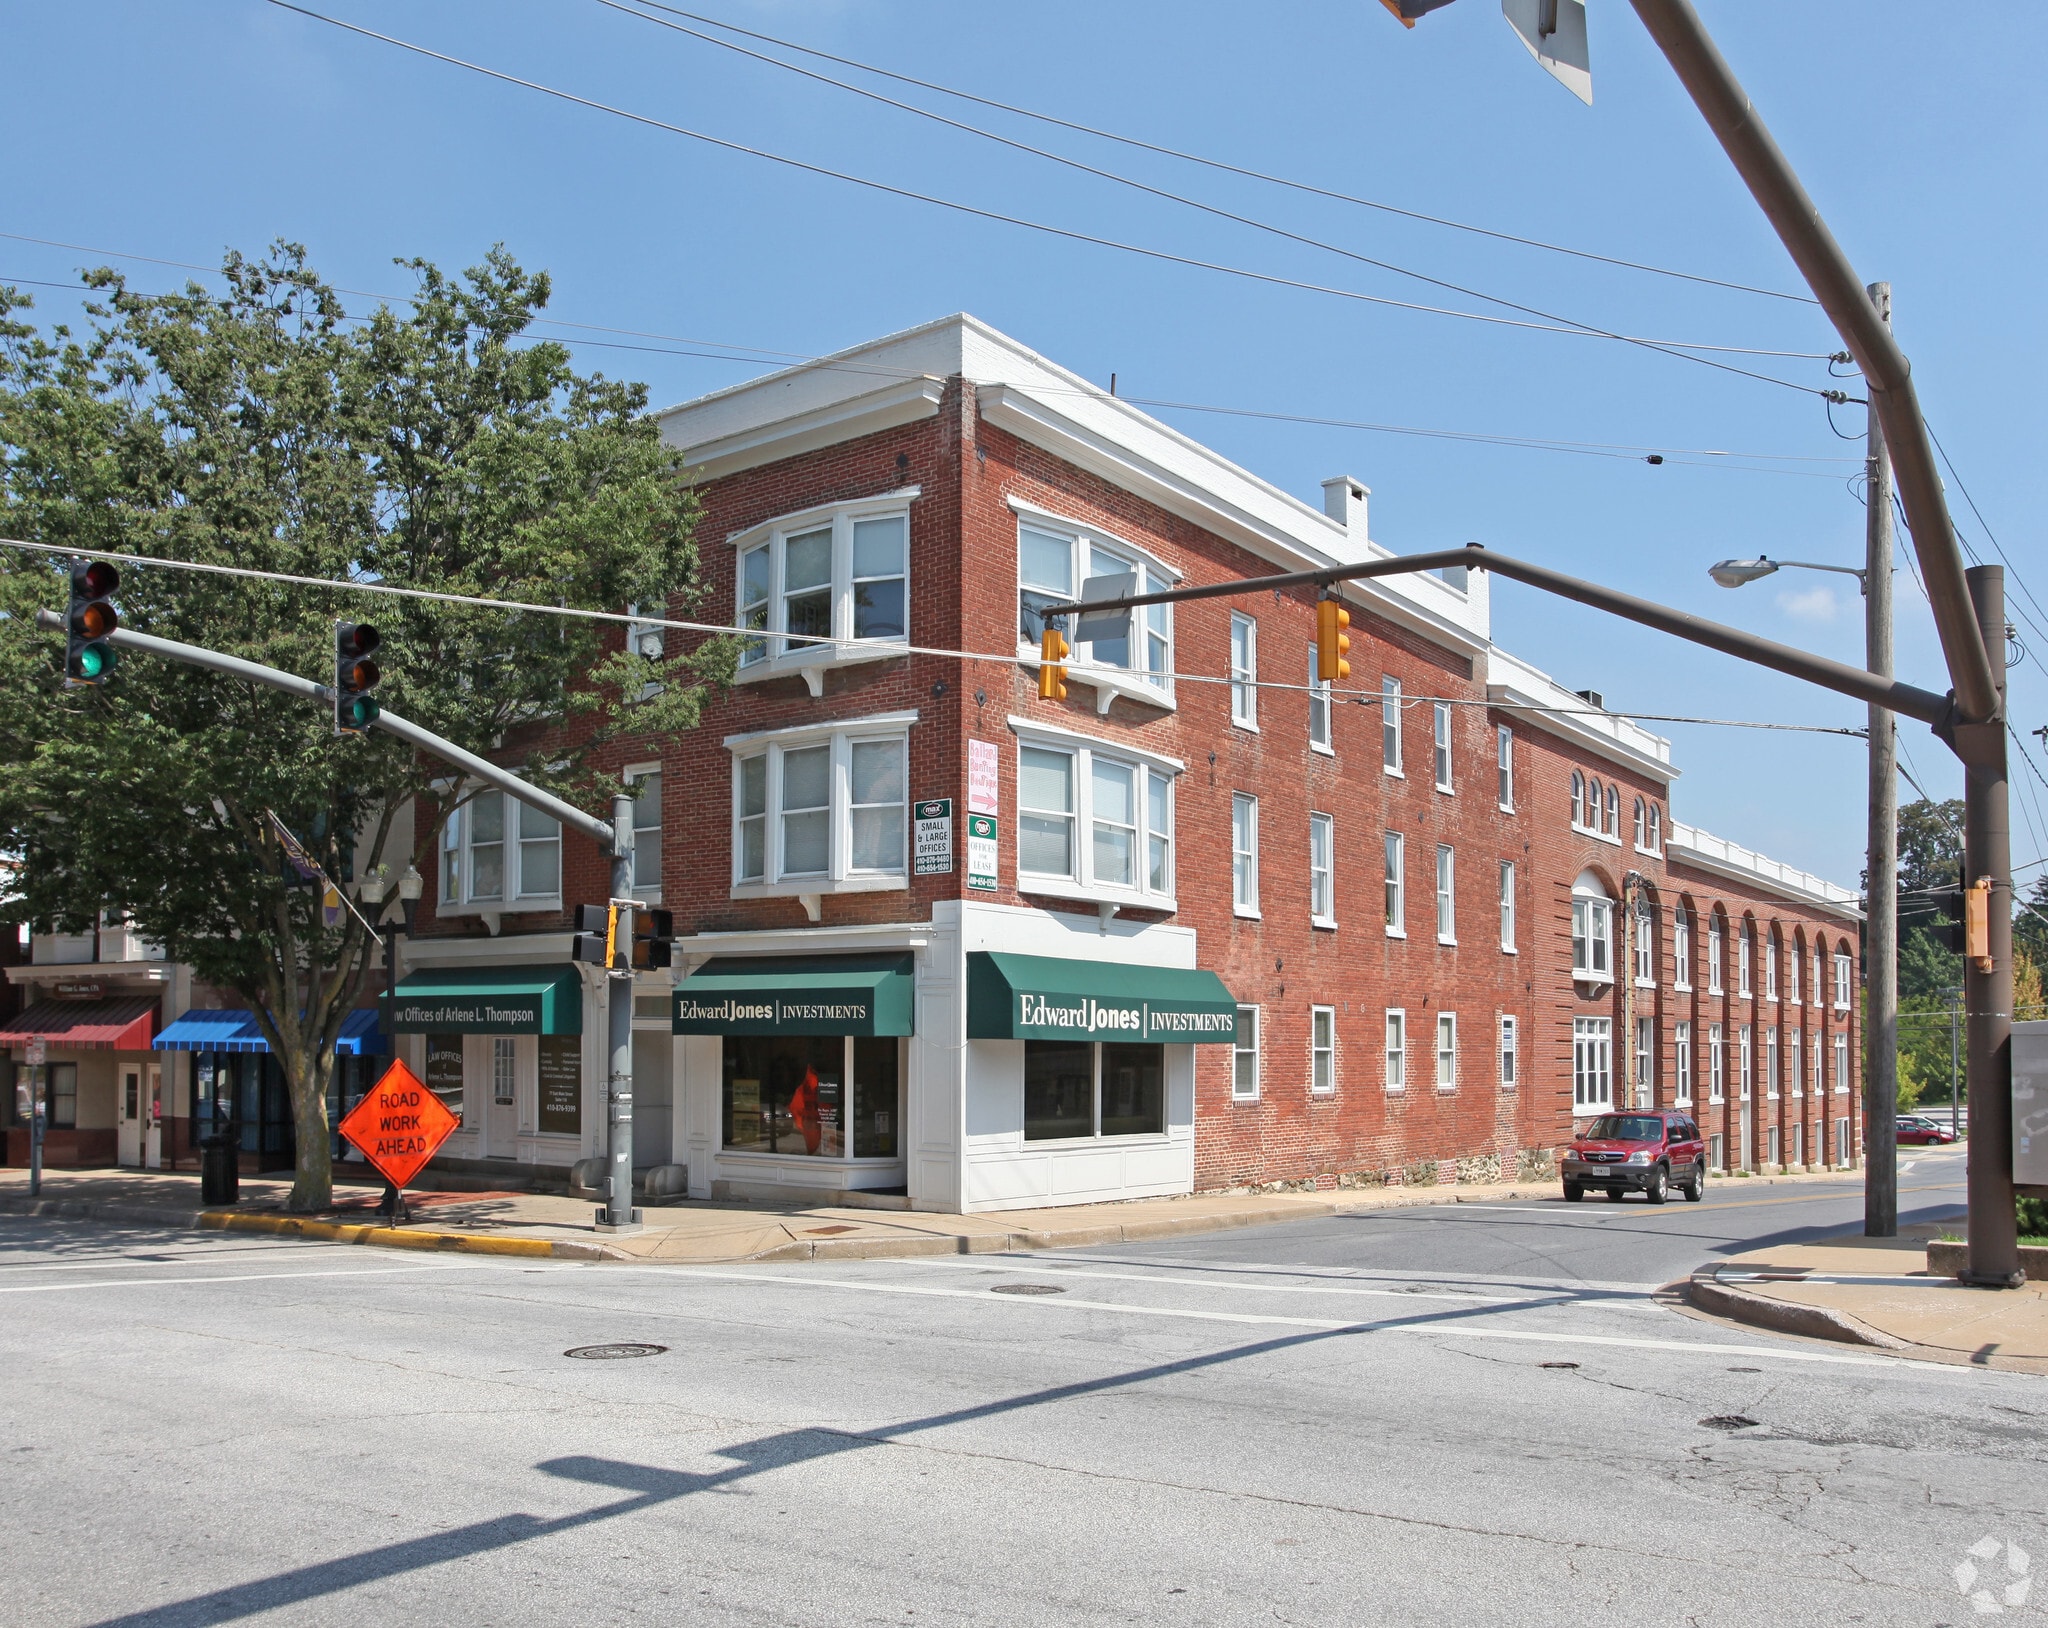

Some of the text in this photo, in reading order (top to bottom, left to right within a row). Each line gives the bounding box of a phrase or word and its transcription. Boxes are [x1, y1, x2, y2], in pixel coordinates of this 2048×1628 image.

[921, 821, 944, 831] SMALL
[917, 831, 948, 842] & LARGE
[919, 842, 947, 853] OFFICES
[970, 842, 996, 853] OFFICES
[973, 860, 993, 871] LEASE
[405, 1007, 434, 1022] Offices
[435, 1007, 444, 1021] of
[446, 1007, 474, 1022] Arlene
[475, 1007, 484, 1021] L.
[485, 1006, 534, 1025] Thompson
[782, 1005, 866, 1019] INVESTMENTS
[1150, 1012, 1233, 1032] INVESTMENTS
[428, 1051, 462, 1063] LAW OFFICES
[380, 1092, 420, 1109] ROAD
[380, 1115, 421, 1131] WORK
[376, 1137, 427, 1156] AHEAD
